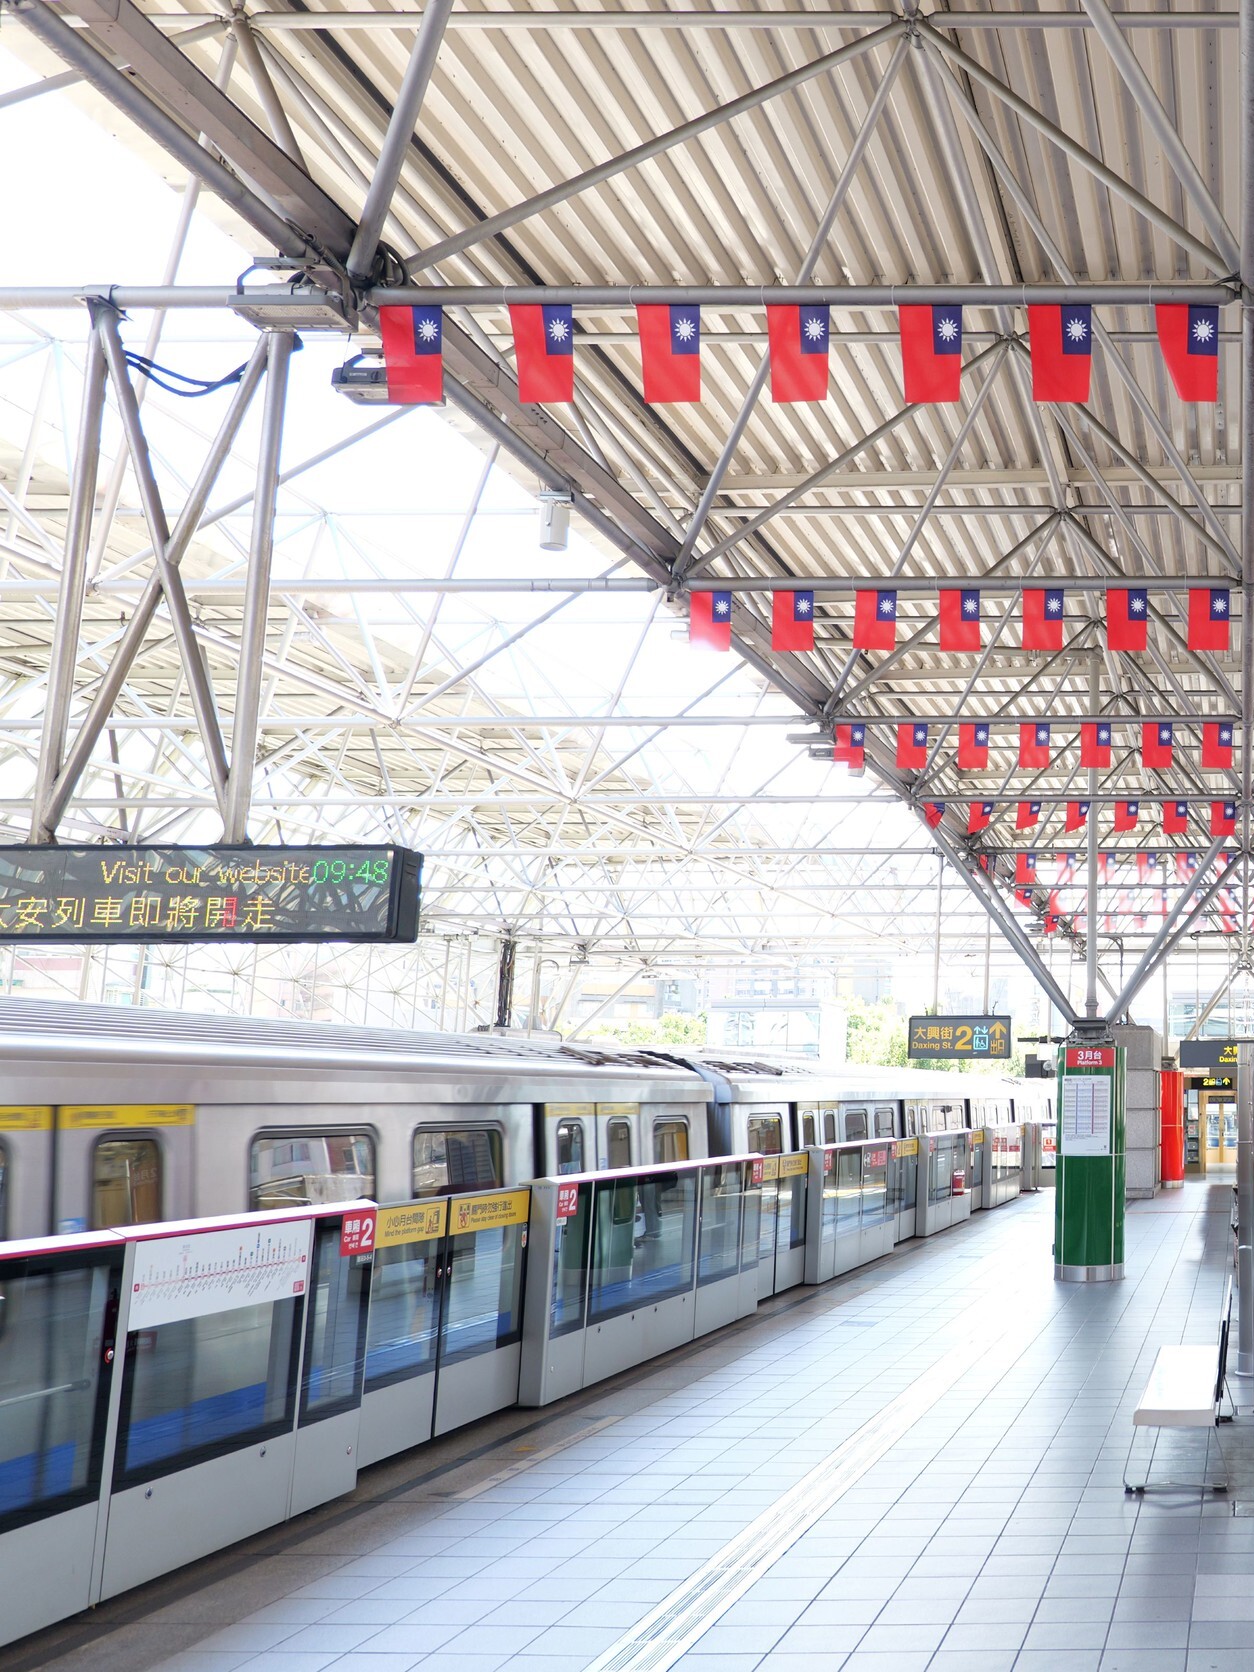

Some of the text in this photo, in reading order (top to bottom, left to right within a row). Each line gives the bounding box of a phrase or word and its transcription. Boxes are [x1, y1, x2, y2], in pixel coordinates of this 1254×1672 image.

[101, 859, 389, 884] Visit our website 09:48
[913, 1026, 953, 1040] 大興街
[954, 1025, 973, 1050] 2
[912, 1041, 953, 1051] Daxing St.
[1077, 1050, 1103, 1060] 3月台
[1219, 1055, 1238, 1063] Daxin
[568, 1189, 577, 1211] 2
[360, 1217, 374, 1247] 2
